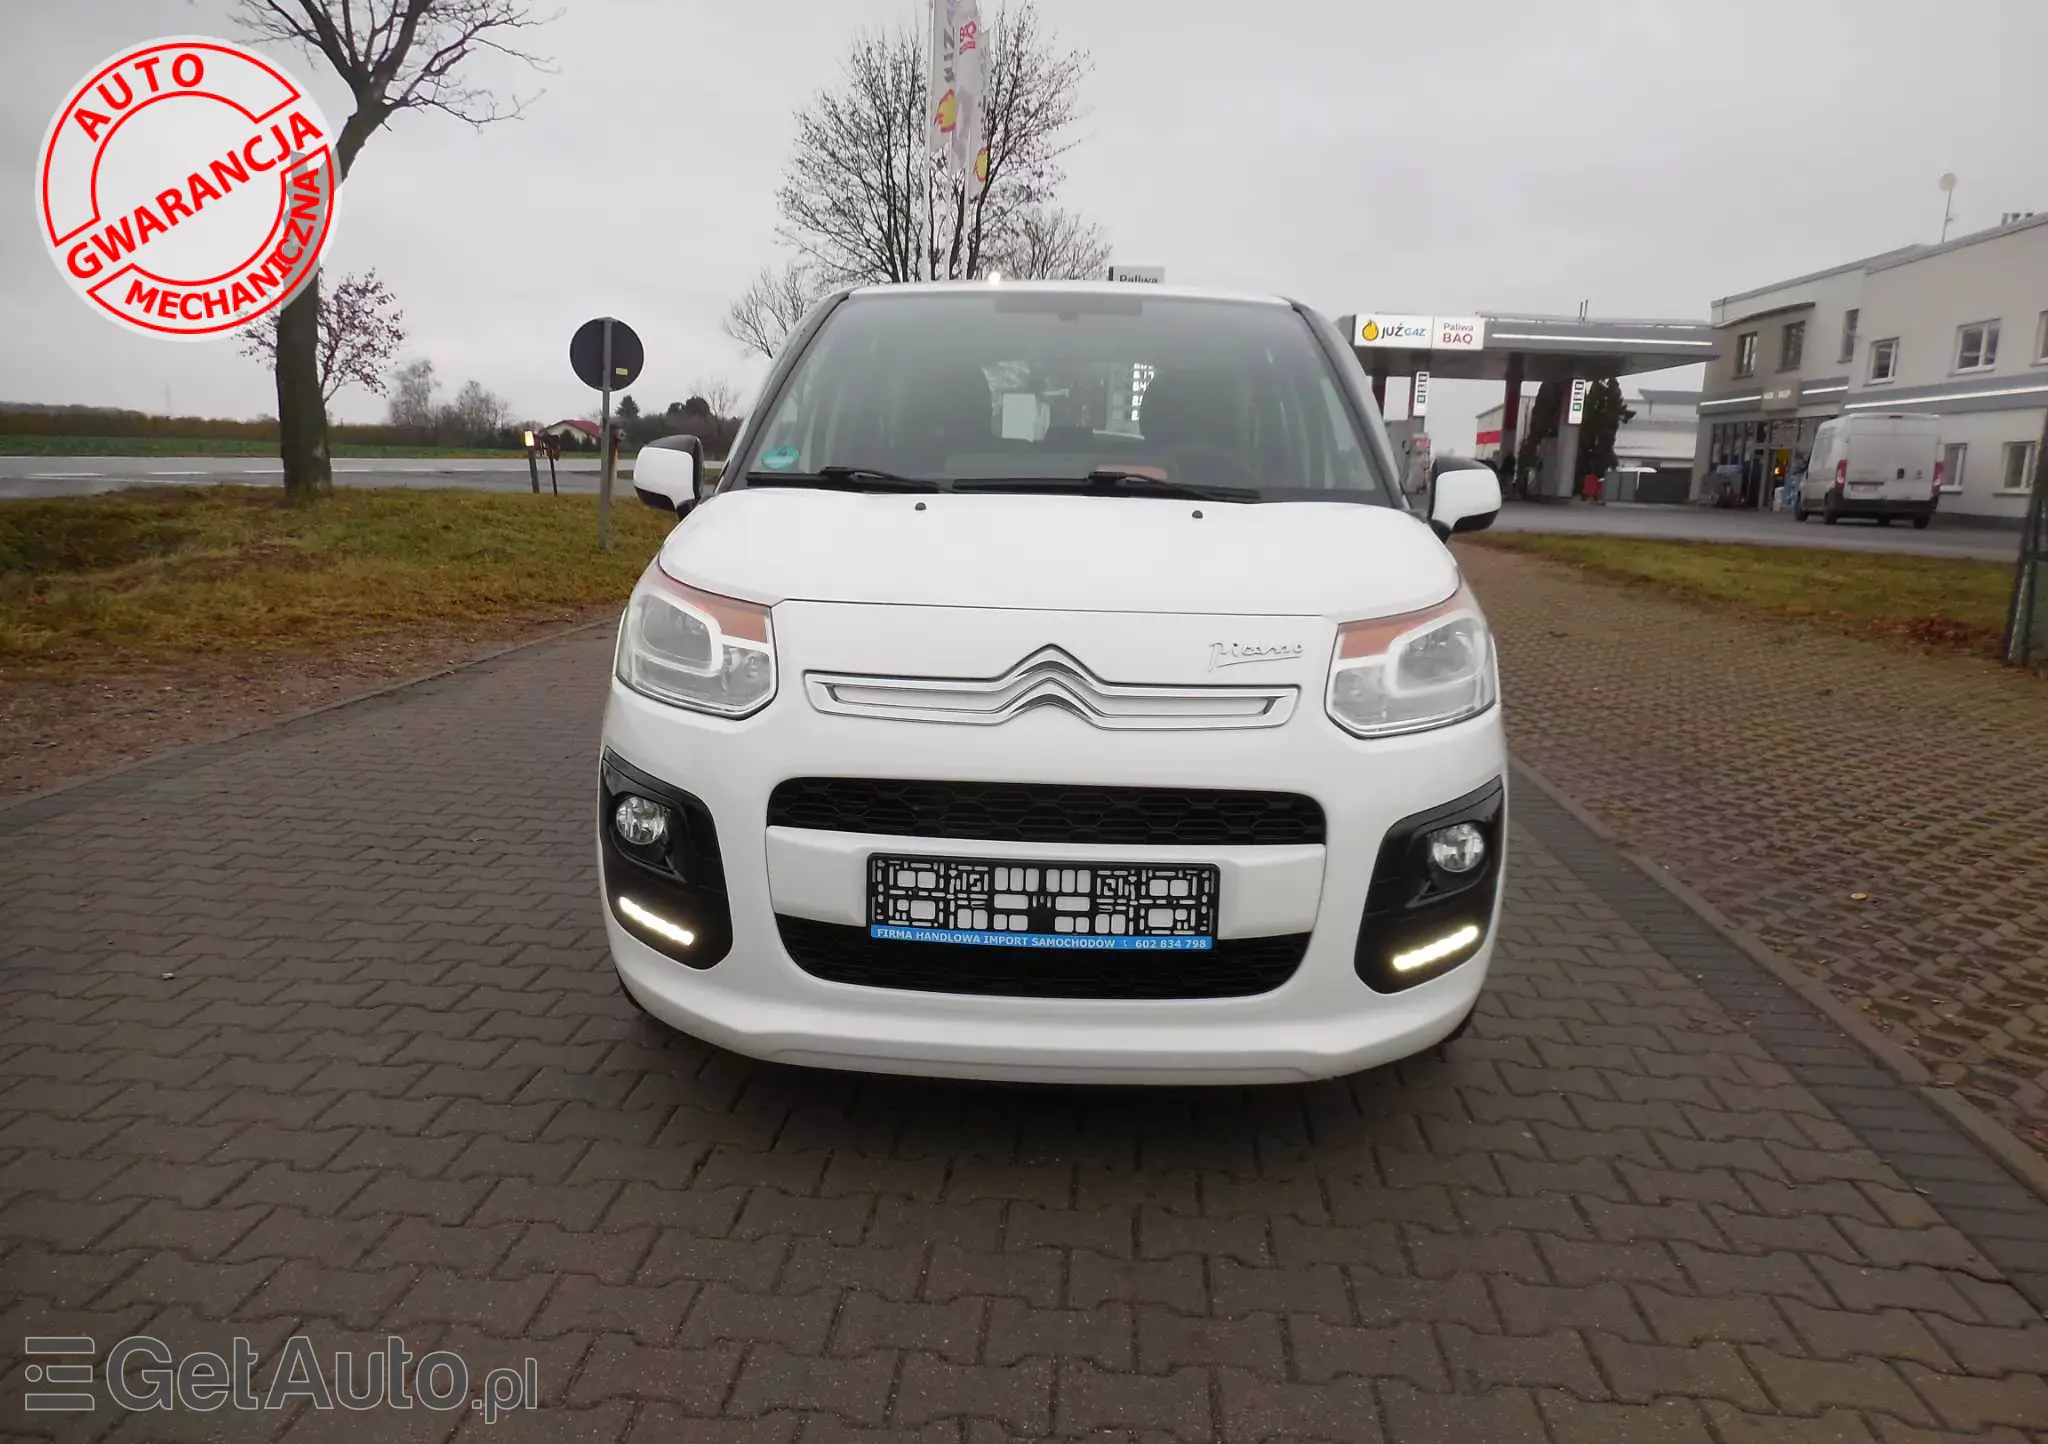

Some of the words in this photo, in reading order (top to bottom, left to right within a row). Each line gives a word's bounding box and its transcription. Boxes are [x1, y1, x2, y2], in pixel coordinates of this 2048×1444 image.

[1443, 322, 1474, 332] Paliwa
[1442, 332, 1473, 344] BAQ
[877, 928, 913, 940] FIRMA
[916, 930, 980, 944] HANDLOWA
[983, 934, 1028, 946] IMPORT
[1135, 939, 1156, 949] 602
[1186, 940, 1208, 949] 798
